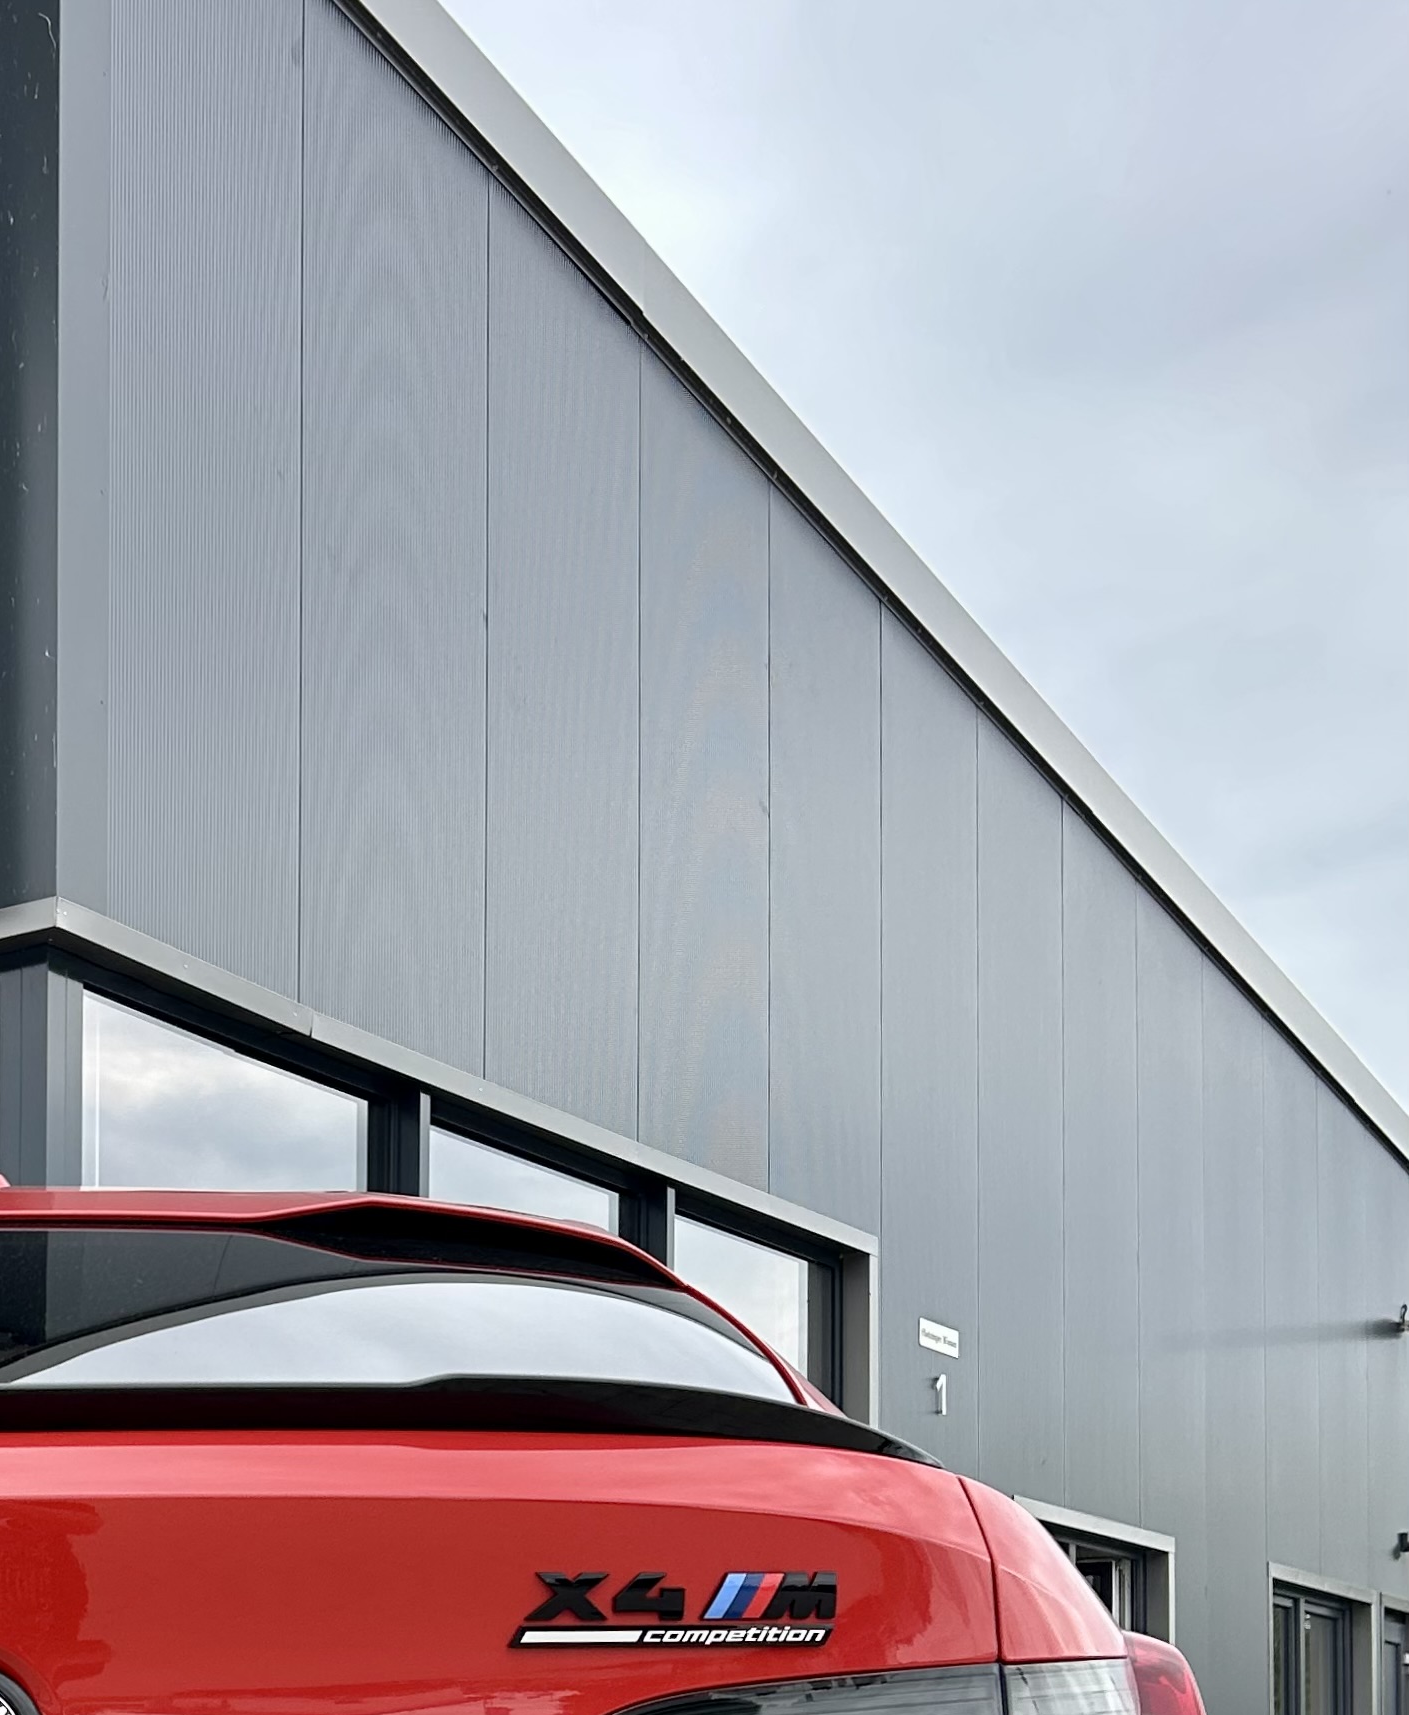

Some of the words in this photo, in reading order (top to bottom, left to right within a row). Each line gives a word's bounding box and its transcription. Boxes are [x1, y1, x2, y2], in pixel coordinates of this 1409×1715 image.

[936, 1374, 947, 1415] 1
[524, 1571, 686, 1621] X4
[643, 1625, 826, 1645] competition
